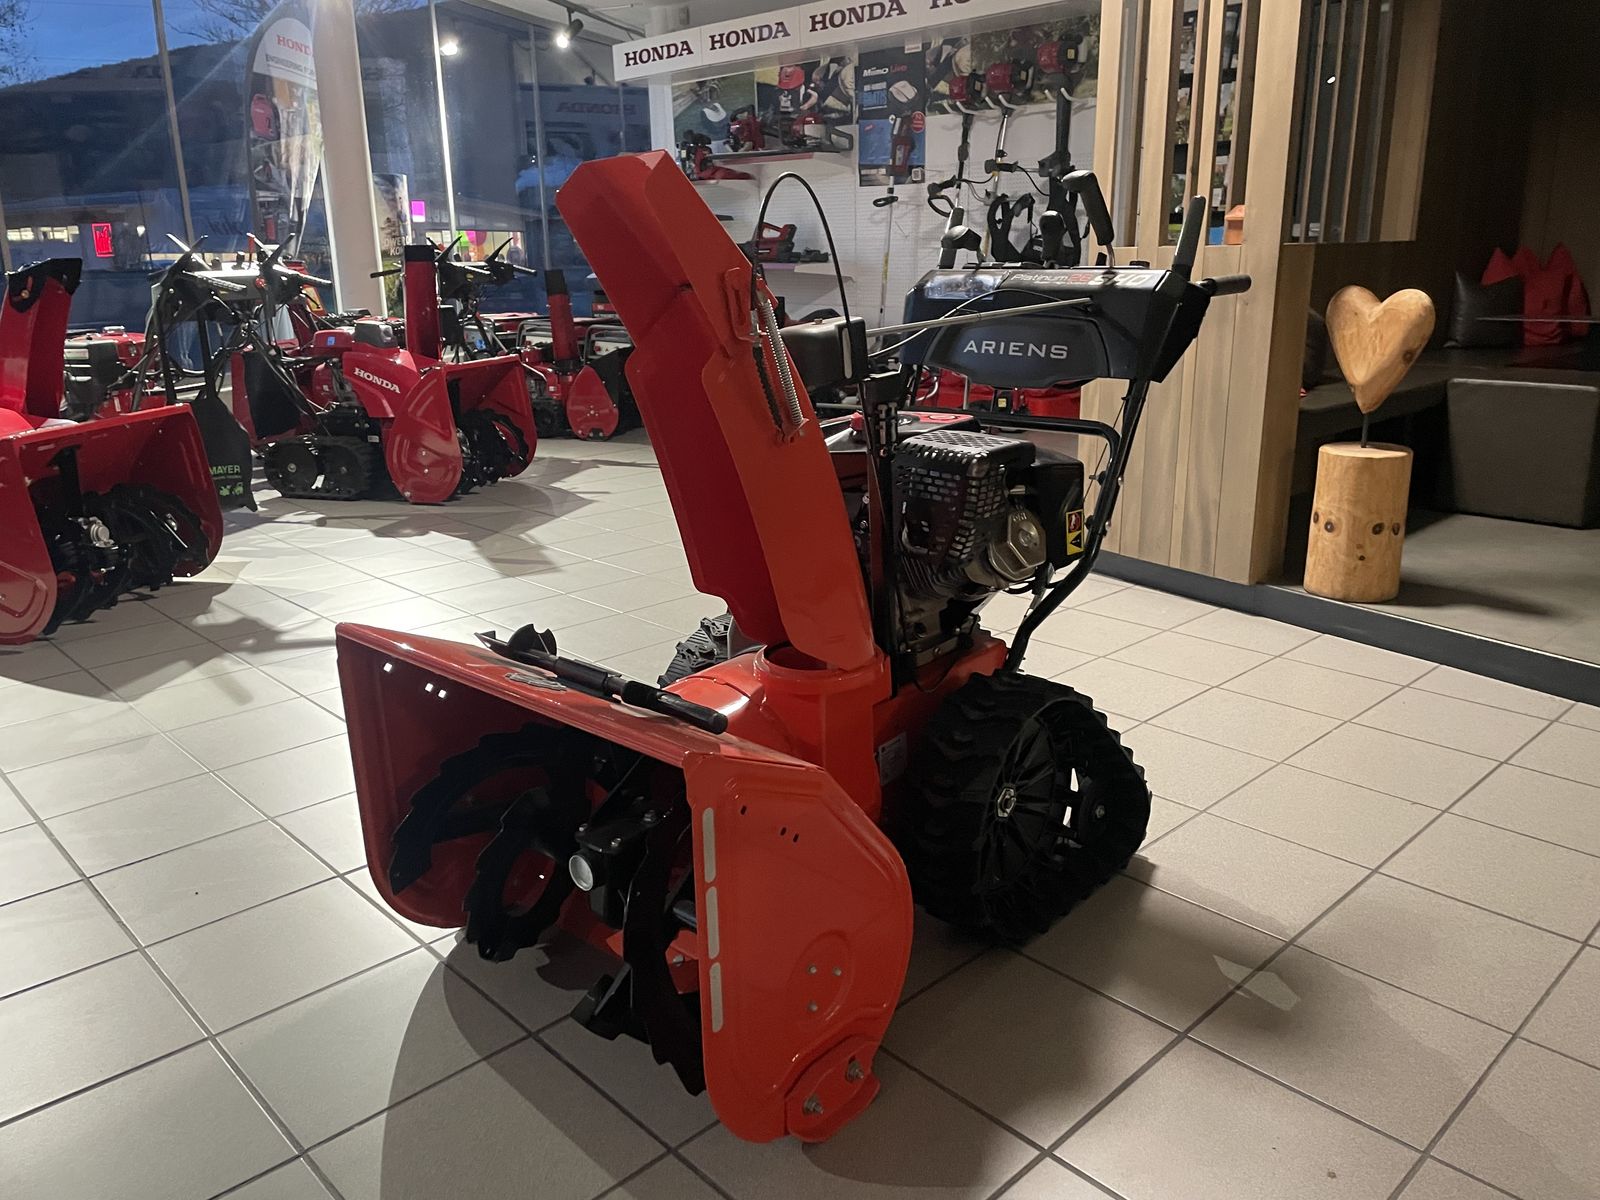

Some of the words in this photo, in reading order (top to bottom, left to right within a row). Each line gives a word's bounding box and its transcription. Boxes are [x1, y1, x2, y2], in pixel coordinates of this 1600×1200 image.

[809, 0, 907, 32] HONDA
[276, 34, 313, 56] HOND
[709, 21, 791, 51] HONDA
[624, 40, 694, 67] HONDA
[1011, 273, 1068, 281] Platinum
[963, 340, 1068, 360] ARIENS
[353, 367, 401, 394] HONDA
